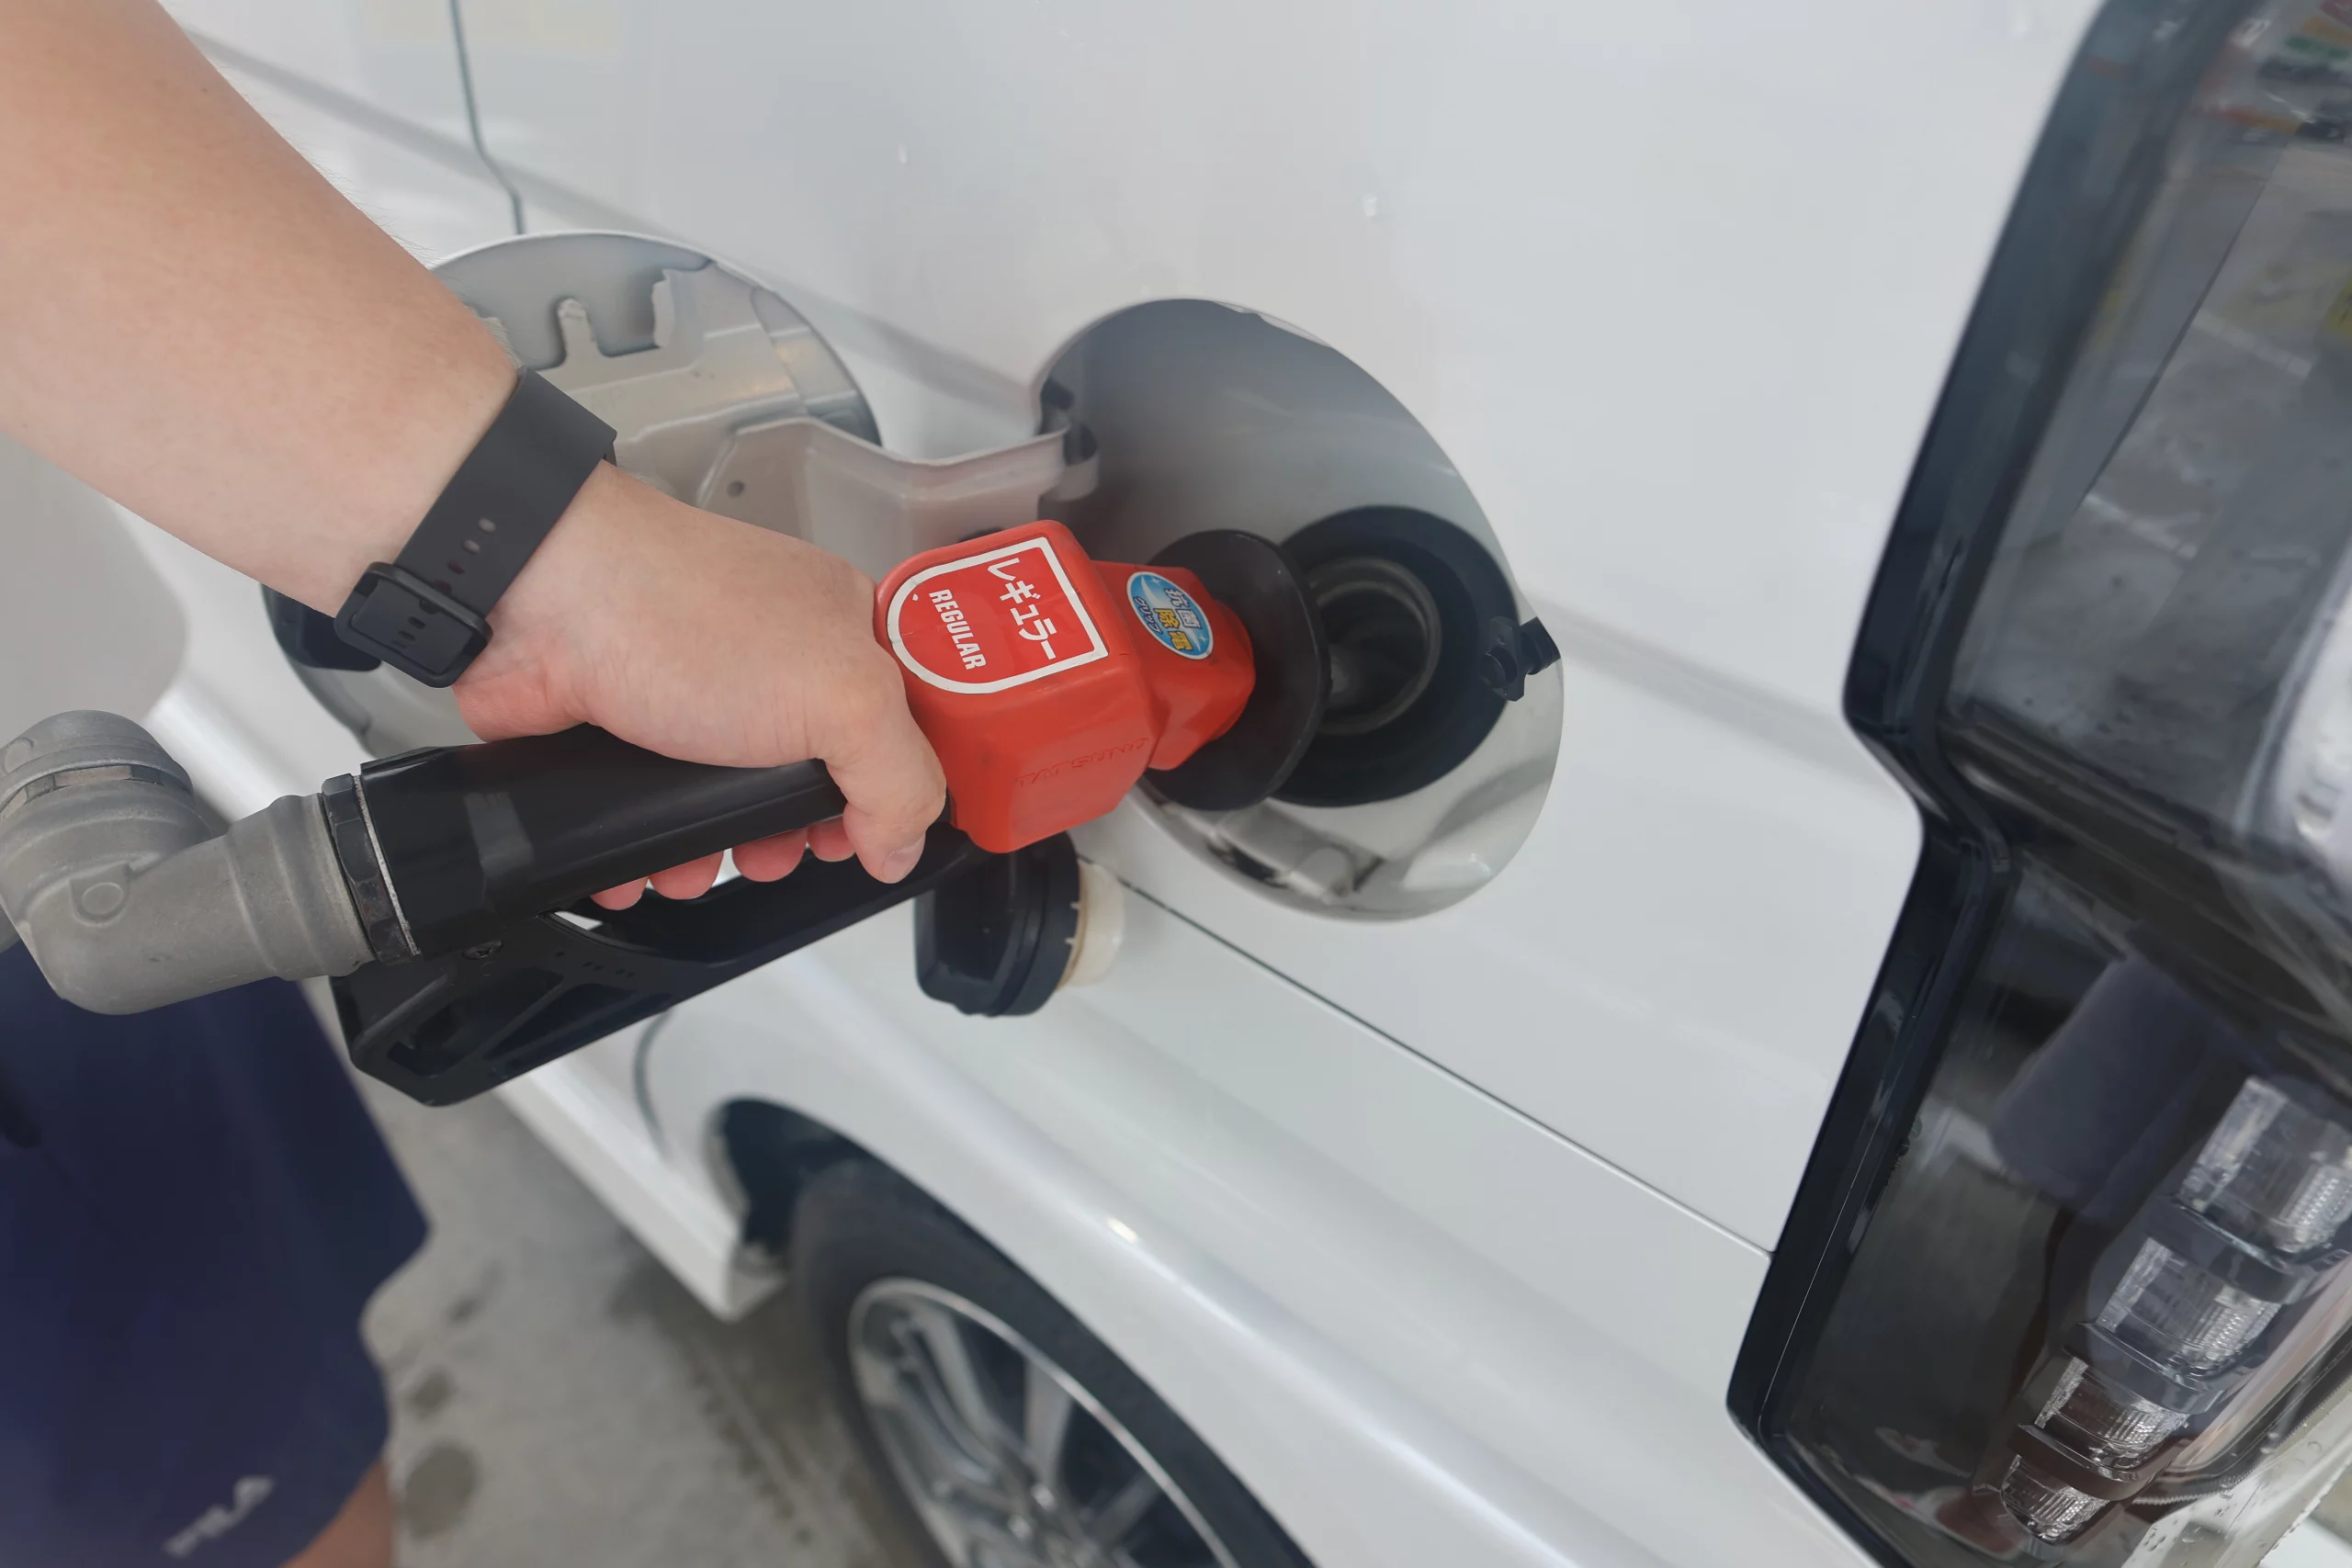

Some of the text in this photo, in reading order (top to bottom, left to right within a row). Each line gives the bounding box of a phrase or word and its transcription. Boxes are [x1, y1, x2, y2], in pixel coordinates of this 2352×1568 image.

[929, 589, 987, 670] REGULAR
[987, 558, 1057, 660] レギュラー
[1015, 738, 1148, 787] TATSUNO
